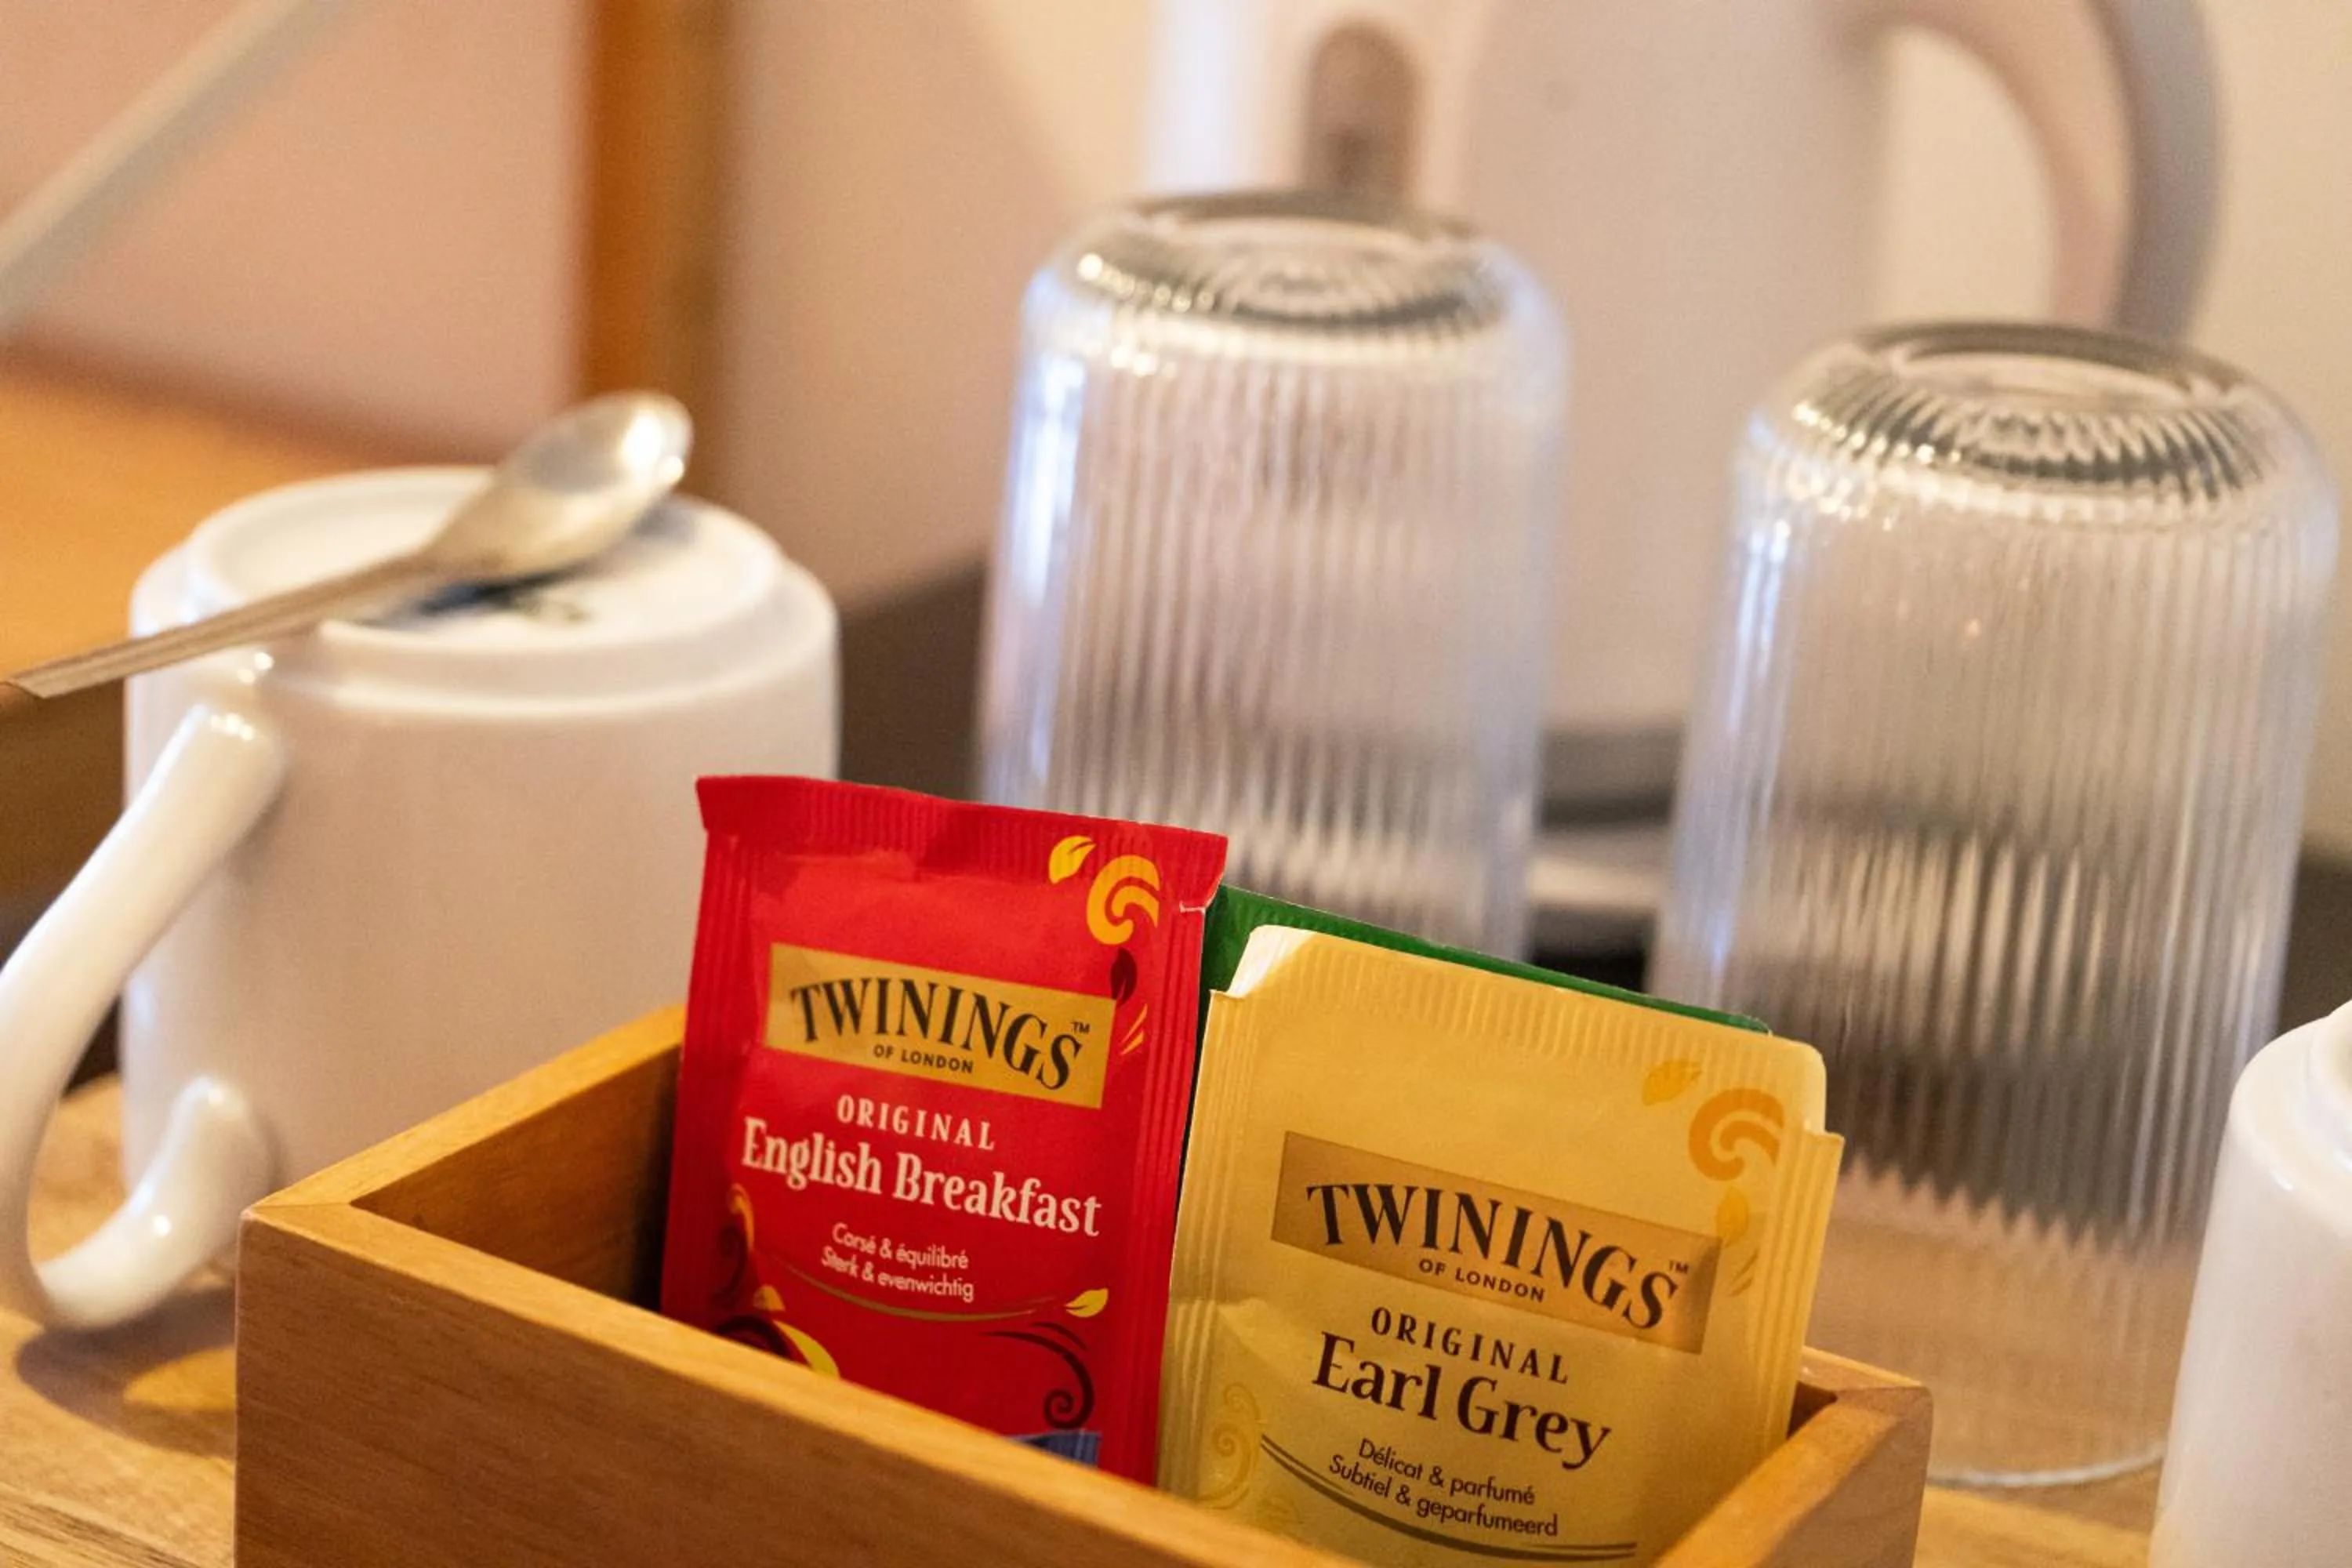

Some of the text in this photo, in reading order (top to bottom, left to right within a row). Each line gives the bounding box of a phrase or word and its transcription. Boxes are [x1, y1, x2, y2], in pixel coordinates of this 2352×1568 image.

[791, 978, 1083, 1091] TWININGS
[873, 1045, 974, 1074] OF LONDON
[837, 1094, 996, 1150] ORIGINAL
[741, 1116, 1102, 1237] English Breakfast
[821, 1246, 975, 1303] Sterk & evenwichtig
[880, 1242, 893, 1259] &
[896, 1243, 970, 1271] équilibré
[1305, 1183, 1680, 1330] TWININGS
[1419, 1258, 1544, 1302] OF LONDON
[1371, 1307, 1569, 1385] ORIGINAL
[1311, 1331, 1611, 1470] Earl Grey
[1329, 1454, 1558, 1537] Subtiel & geparfumeerd
[1358, 1438, 1535, 1506] Délicat & parfumé
